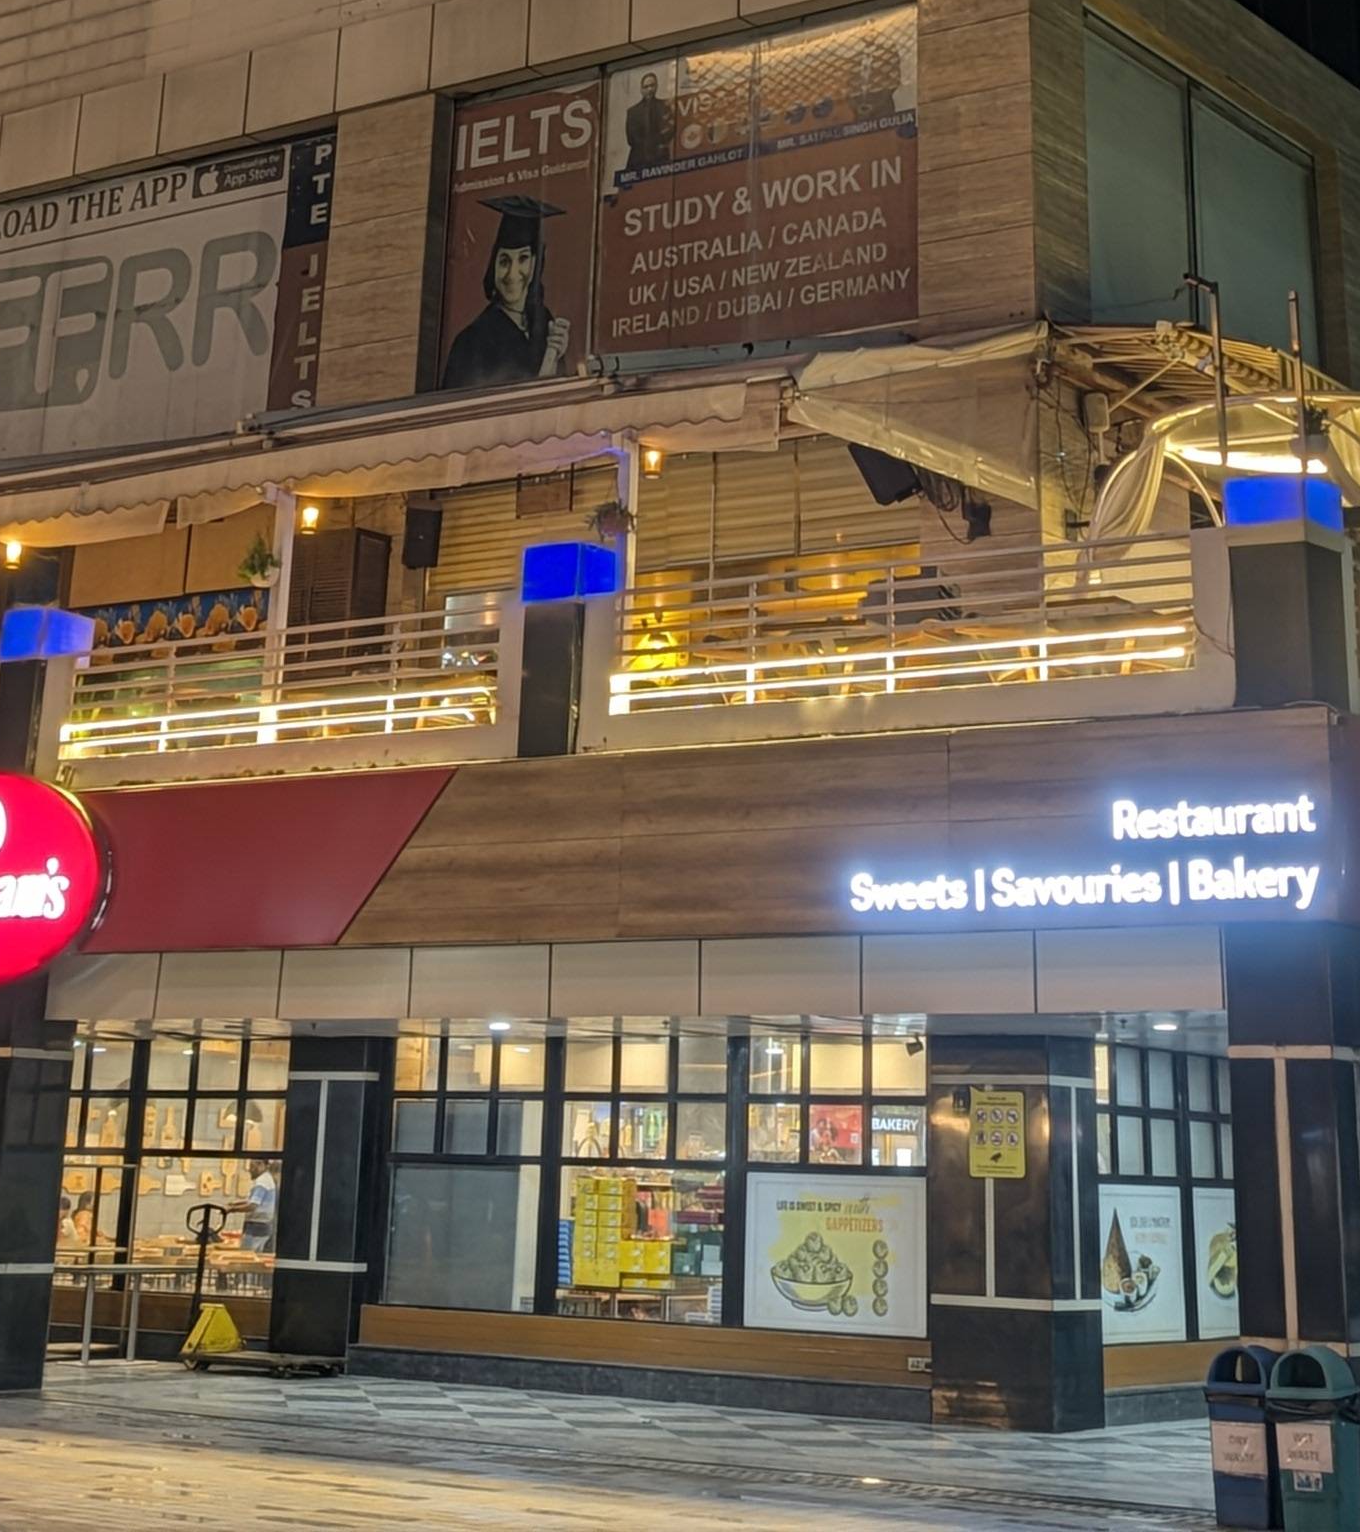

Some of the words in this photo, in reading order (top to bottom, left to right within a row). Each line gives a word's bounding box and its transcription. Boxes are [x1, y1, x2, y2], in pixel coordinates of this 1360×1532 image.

[455, 99, 593, 171] IELTS
[66, 183, 123, 227] THE
[128, 171, 188, 212] APP
[223, 173, 247, 188] App
[248, 166, 277, 183] Store
[623, 190, 725, 237] STUDY
[732, 186, 752, 216] &
[761, 163, 862, 210] WORK
[871, 156, 902, 189] IN
[630, 230, 764, 275] AUSTRALIA
[782, 206, 887, 246] CANADA
[611, 304, 701, 338] IRELAND
[716, 292, 783, 320] DUBAI
[799, 266, 911, 306] GERMANY
[627, 283, 657, 306] UK
[672, 275, 716, 299] USA
[731, 260, 781, 288] NEW
[784, 242, 888, 279] ZEALAND
[1111, 794, 1317, 841] Restaurant
[848, 870, 969, 913] Sweets
[990, 863, 1162, 908] Savouries
[1187, 856, 1321, 910] Bakery
[871, 1117, 919, 1131] BAKERY
